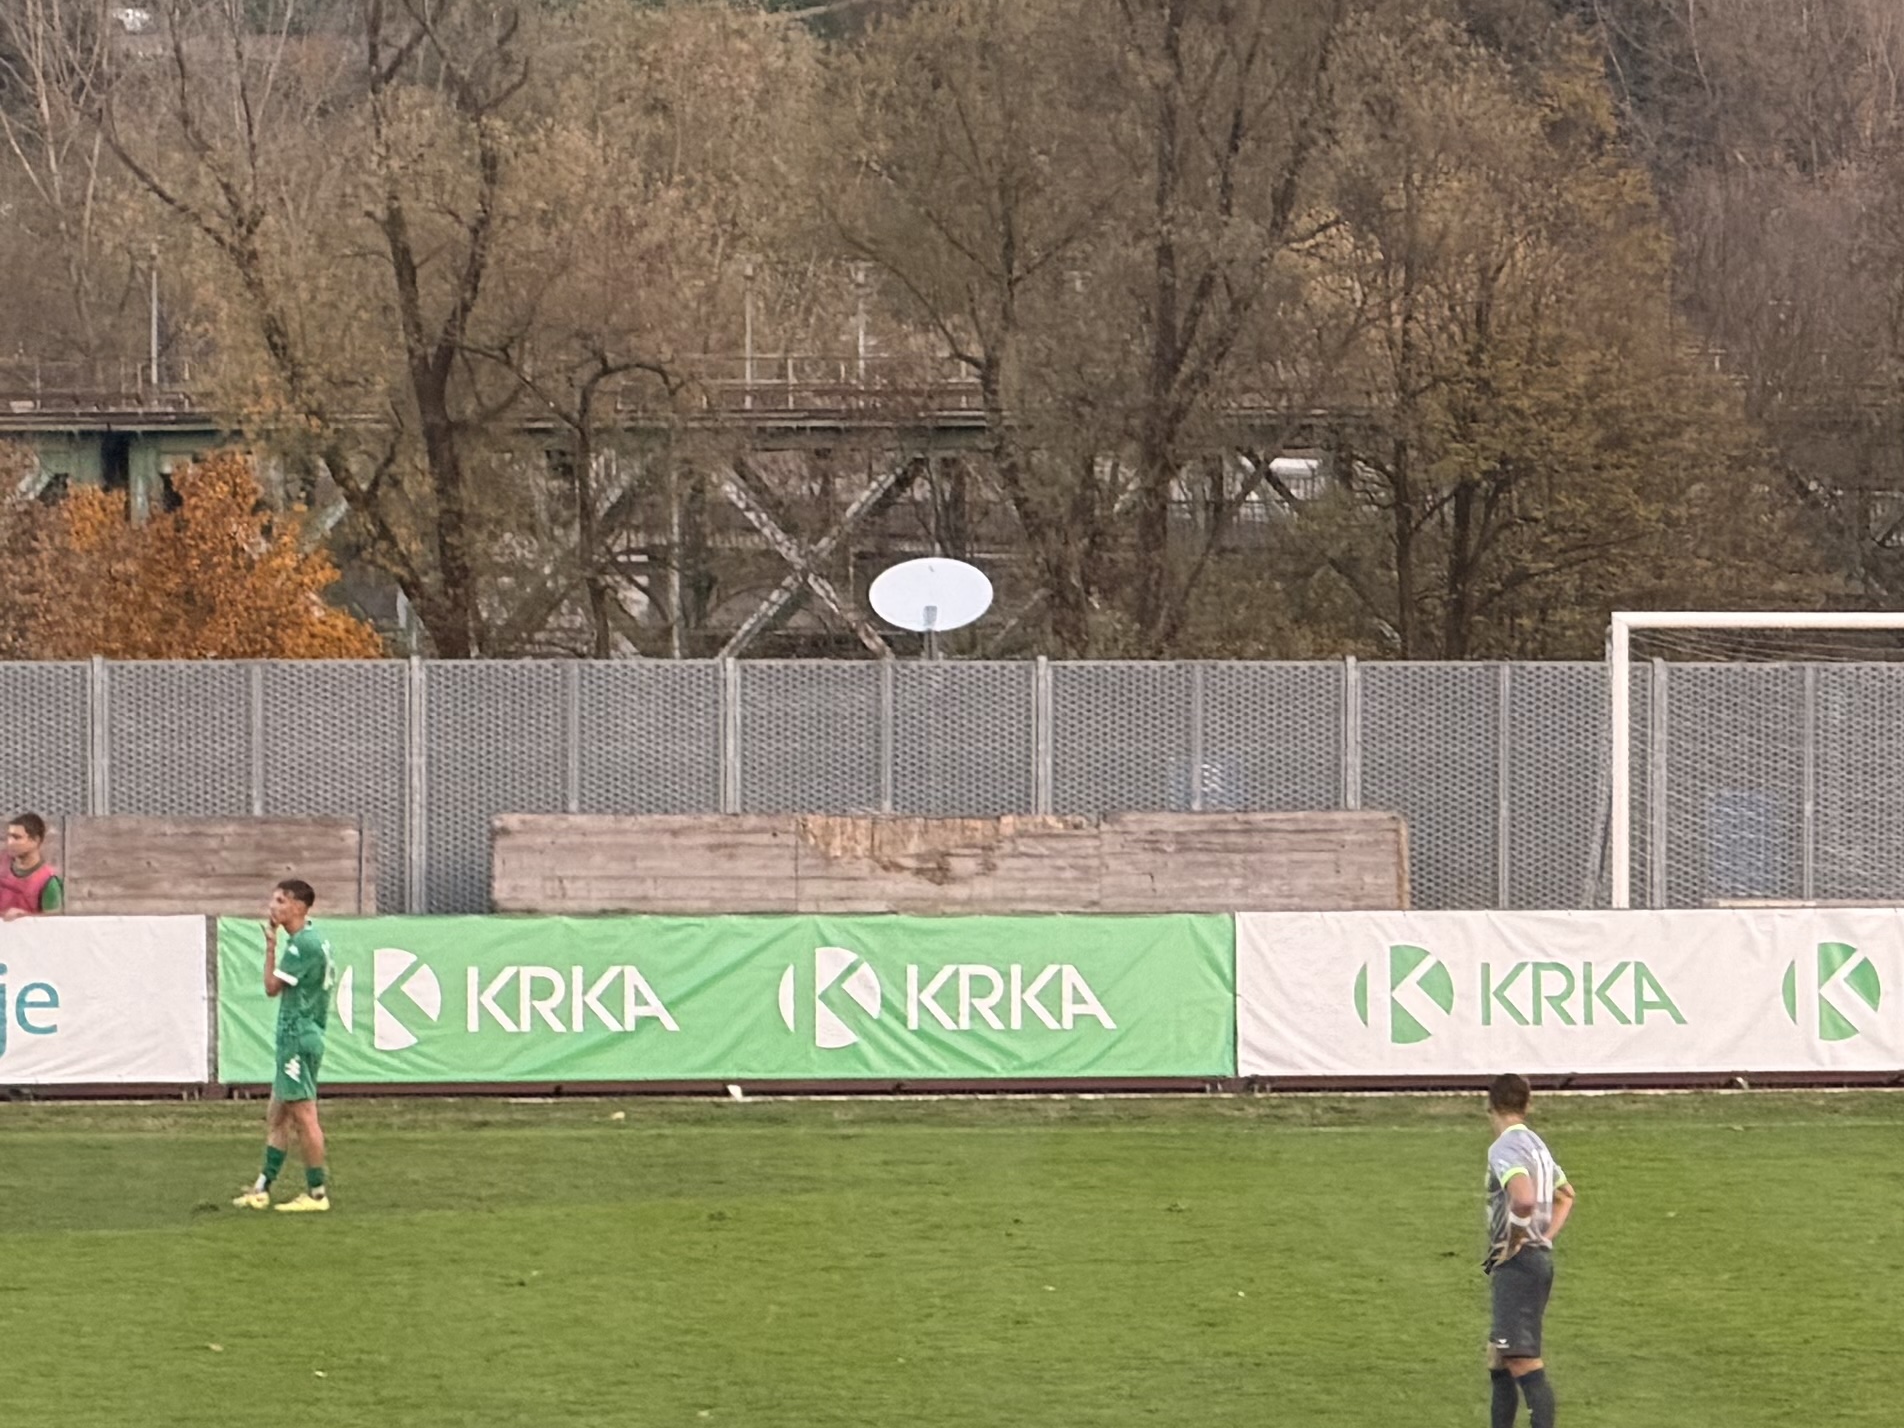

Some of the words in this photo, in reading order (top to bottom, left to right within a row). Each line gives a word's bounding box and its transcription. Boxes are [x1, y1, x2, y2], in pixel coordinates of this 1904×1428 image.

[467, 965, 681, 1033] KRKA
[906, 964, 1118, 1030] KRKA
[1481, 961, 1687, 1027] KRKA
